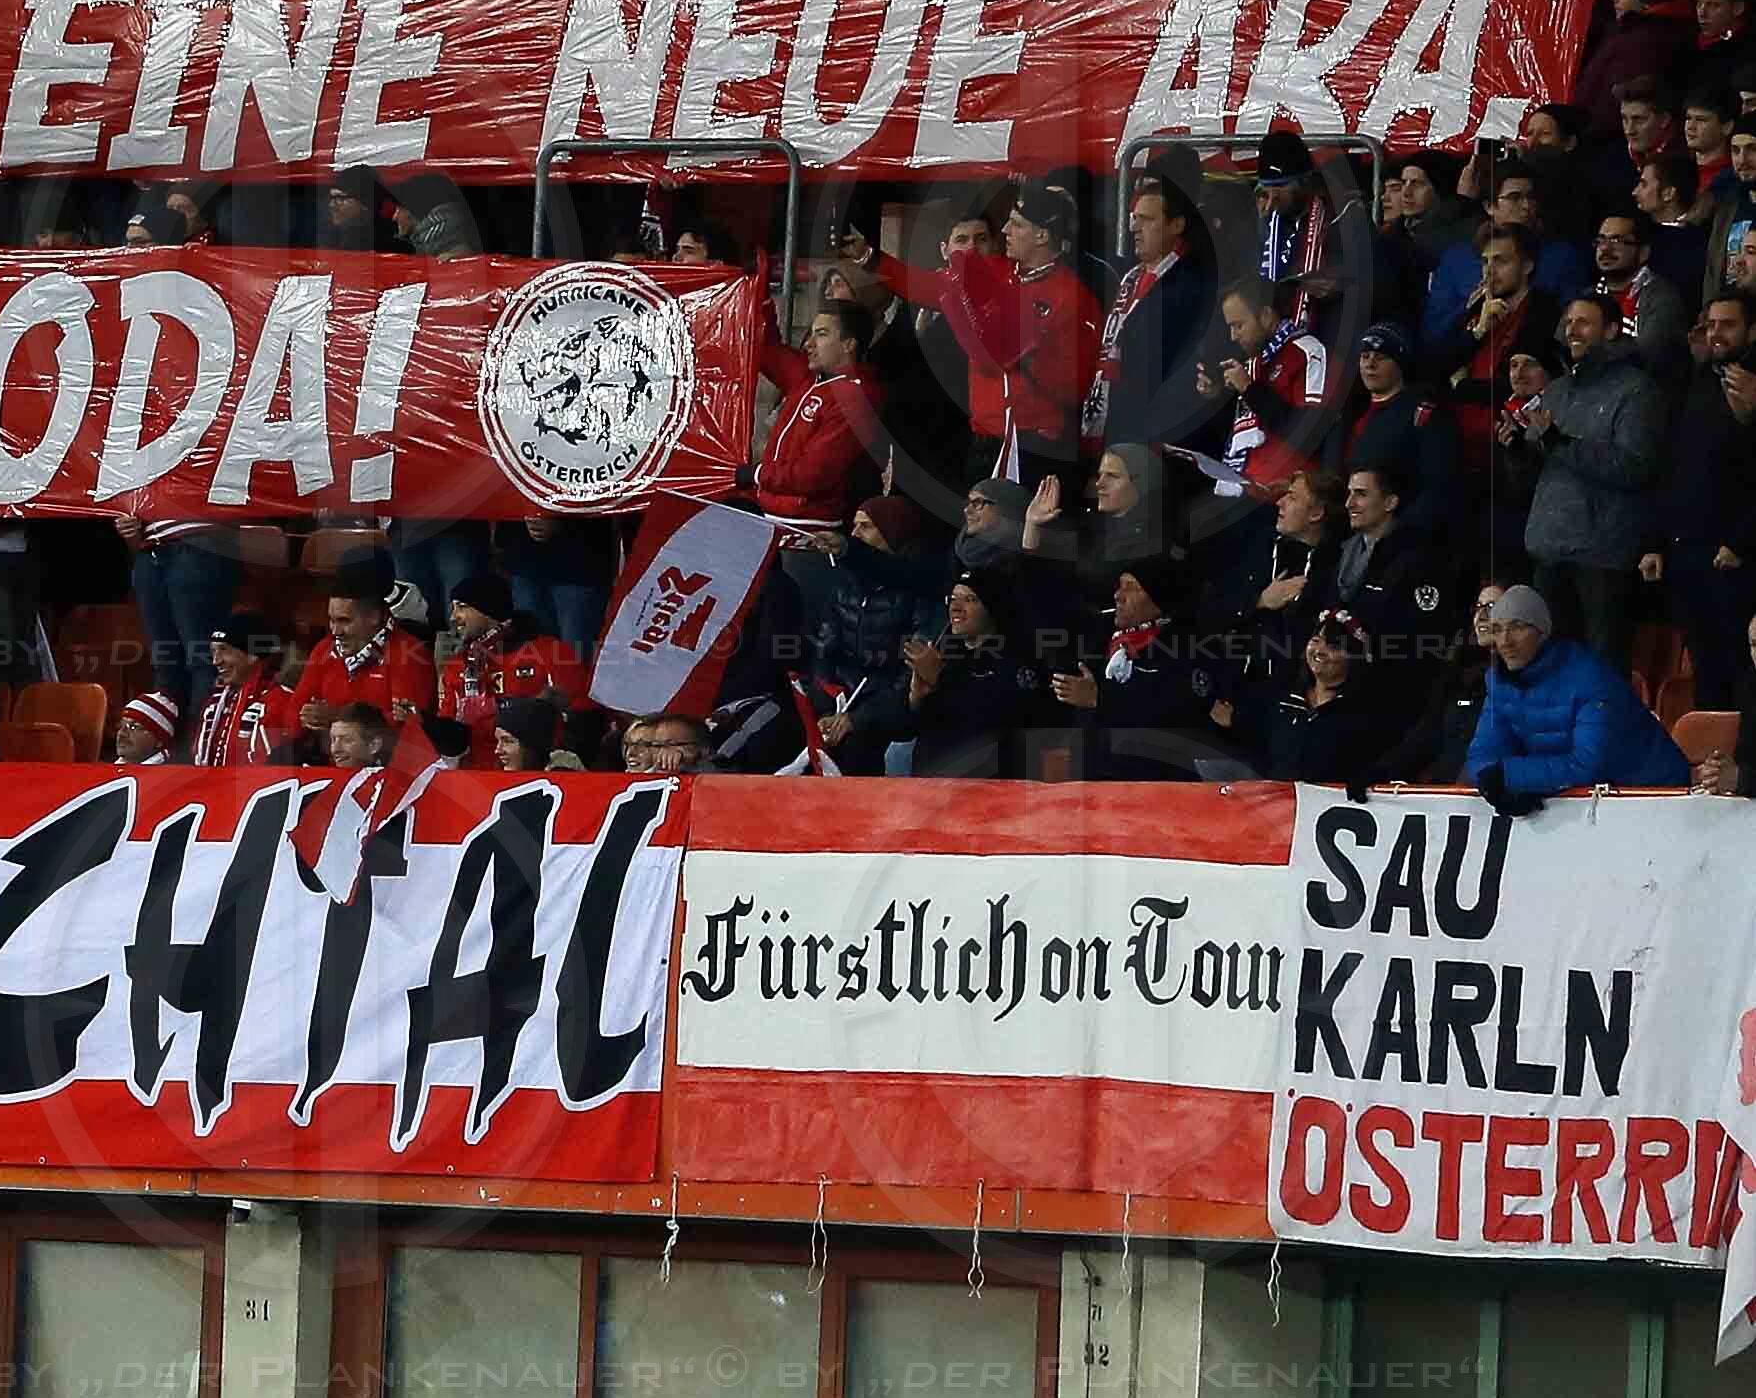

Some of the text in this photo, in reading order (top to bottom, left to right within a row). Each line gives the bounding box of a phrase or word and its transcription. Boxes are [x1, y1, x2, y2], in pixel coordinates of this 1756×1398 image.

[520, 440, 639, 484] ÖSTERREICH
[1306, 806, 1514, 941] SAU
[681, 893, 1026, 1022] Fürstlich
[1040, 934, 1113, 1005] on
[1293, 951, 1633, 1099] KARLN
[246, 1299, 269, 1321] 31
